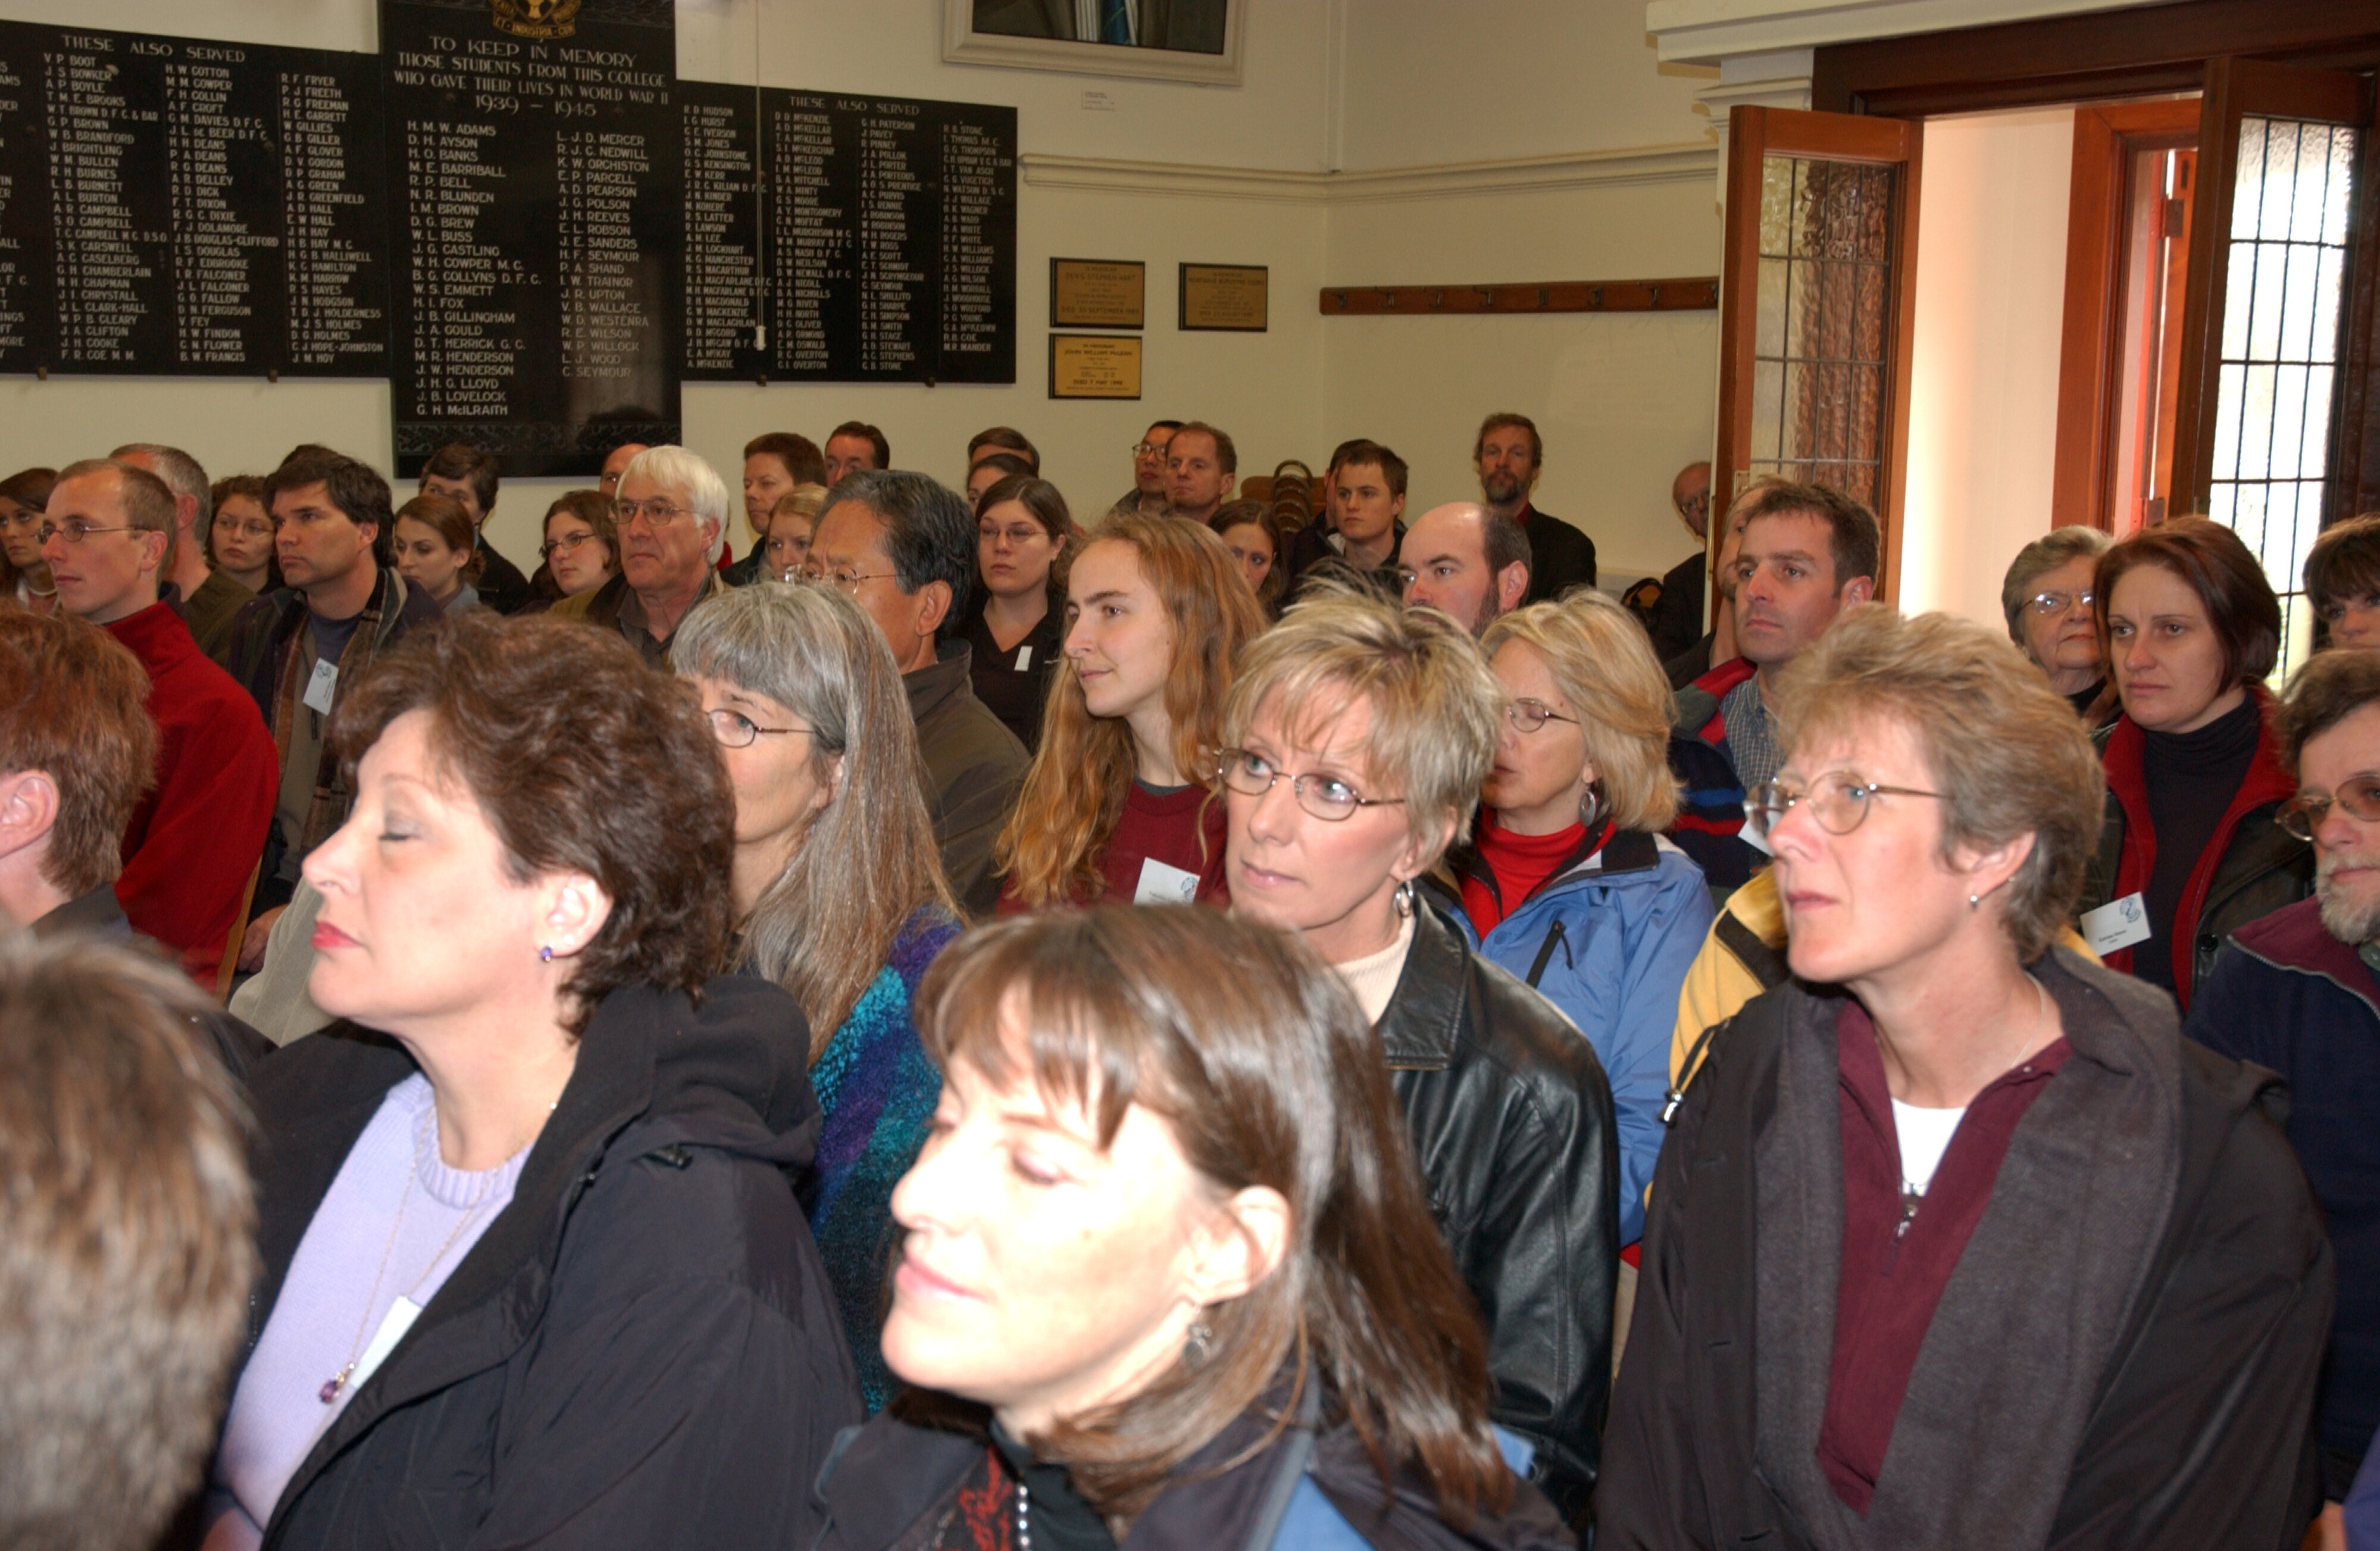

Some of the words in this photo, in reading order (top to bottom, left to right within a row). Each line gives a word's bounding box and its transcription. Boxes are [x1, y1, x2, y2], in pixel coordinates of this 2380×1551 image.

[61, 35, 115, 52] THESE
[130, 42, 173, 57] ALSO
[186, 46, 245, 62] SERVED
[430, 36, 456, 52] TO
[468, 40, 520, 57] KEEP
[531, 45, 547, 59] IN
[560, 48, 636, 67] MEMORY
[69, 55, 96, 67] BOOT
[70, 68, 112, 81] BOWKER
[190, 65, 229, 77] COTTON
[399, 52, 445, 69] THOSE
[452, 57, 521, 74] STUDENTS
[528, 63, 566, 79] FROM
[574, 67, 602, 82] THIS
[608, 71, 666, 87] COLLEGE
[192, 78, 233, 90] COWPER
[304, 74, 335, 86] FRYER
[71, 80, 105, 92] BOYLE
[395, 70, 424, 85] WHO
[431, 74, 467, 89] GAVE
[474, 77, 511, 92] THEIR
[518, 80, 553, 95] LIVES
[560, 84, 573, 97] IN
[580, 86, 623, 101] WORLD
[629, 90, 654, 104] WAR
[661, 92, 668, 105] II
[86, 94, 126, 107] BROOKS
[190, 90, 227, 102] COLLIN
[305, 99, 349, 111] FREEMAN
[476, 94, 519, 115] 1939
[555, 101, 597, 117] 1945
[790, 96, 825, 108] THESE
[836, 99, 867, 111] ALSO
[877, 103, 919, 115] SERVED
[73, 118, 109, 129] BROWN
[193, 114, 230, 126] DAVIES
[295, 121, 333, 133] GILLIES
[455, 123, 496, 136] ADAMS
[75, 130, 135, 143] BRANDFORD
[306, 134, 340, 145] GILLER
[439, 136, 478, 148] AYSON
[599, 133, 645, 146] MERCER
[61, 142, 123, 155] BRIGHTLING
[193, 139, 226, 149] DEANS
[194, 151, 227, 161] DEANS
[307, 146, 343, 156] GLOVER
[439, 149, 478, 161] BANKS
[599, 146, 648, 159] NEDWILL
[78, 156, 118, 167] BULLEN
[587, 159, 649, 171] ORCHISTON
[76, 168, 117, 179] BURNES
[308, 169, 345, 179] GRAHAM
[440, 162, 506, 177] BARRIBALL
[439, 176, 471, 188] BELL
[586, 171, 636, 184] PARCELL
[77, 180, 123, 192] BURNETT
[308, 181, 339, 190] GREEN
[586, 185, 637, 197] PEARSON
[77, 192, 118, 204] BURTON
[440, 190, 495, 203] BLUNDEN
[196, 198, 226, 208] DIXON
[586, 198, 630, 209] POLSON
[79, 205, 132, 216] CAMPBELL
[309, 205, 333, 214] HALL
[437, 204, 479, 215] BROWN
[209, 211, 236, 221] DIXIE
[586, 211, 630, 223] REEVES
[79, 217, 132, 228] CAMPBELL
[197, 223, 248, 233] DOLAMORE
[440, 217, 475, 229] BREW
[310, 227, 329, 236] HAY
[587, 224, 631, 236] ROBSON
[441, 231, 473, 242] BUSS
[80, 241, 132, 252] CARSWELL
[587, 237, 637, 249] SANDERS
[196, 246, 240, 257] DOUGLAS
[587, 250, 639, 261] SEYMOUR
[311, 262, 356, 271] HAMILTON
[443, 258, 492, 269] COWPER
[589, 263, 624, 273] SHAND
[82, 266, 151, 277] CHAMBERLAIN
[196, 270, 246, 280] FALCONER
[442, 271, 496, 283] COLLYNS
[82, 278, 130, 288] CHAPMAN
[587, 276, 633, 286] TRAINOR
[311, 285, 342, 294] HAYES
[443, 284, 494, 296] EMMETT
[589, 289, 624, 299] UPTON
[80, 290, 138, 301] CHRYSTALL
[201, 293, 240, 304] FALLOW
[312, 296, 354, 306] HODGSON
[84, 302, 148, 313] CLARK-HALL
[439, 298, 464, 308] FOX
[589, 302, 640, 313] WALLACE
[201, 305, 251, 315] FERGUSON
[98, 315, 137, 324] CLEARY
[190, 315, 209, 325] FEY
[443, 311, 515, 323] GILLINGHAM
[590, 315, 649, 326] WESTENRA
[326, 320, 362, 329] HOLMES
[85, 326, 129, 336] CLIFTON
[204, 329, 240, 337] FINDON
[444, 326, 483, 335] GOULD
[590, 328, 631, 338] WILSON
[86, 338, 118, 348] COOKE
[203, 340, 243, 349] FLOWER
[444, 338, 495, 349] HERRICK
[591, 341, 639, 351] WILLOCK
[86, 350, 107, 360] COE
[205, 352, 246, 361] FRANCIS
[446, 351, 514, 362] HENDERSON
[446, 365, 514, 375] HENDERSON
[576, 367, 631, 377] SEYMOUR
[460, 379, 499, 389] LLOYD
[445, 392, 506, 402] LOVELOCK
